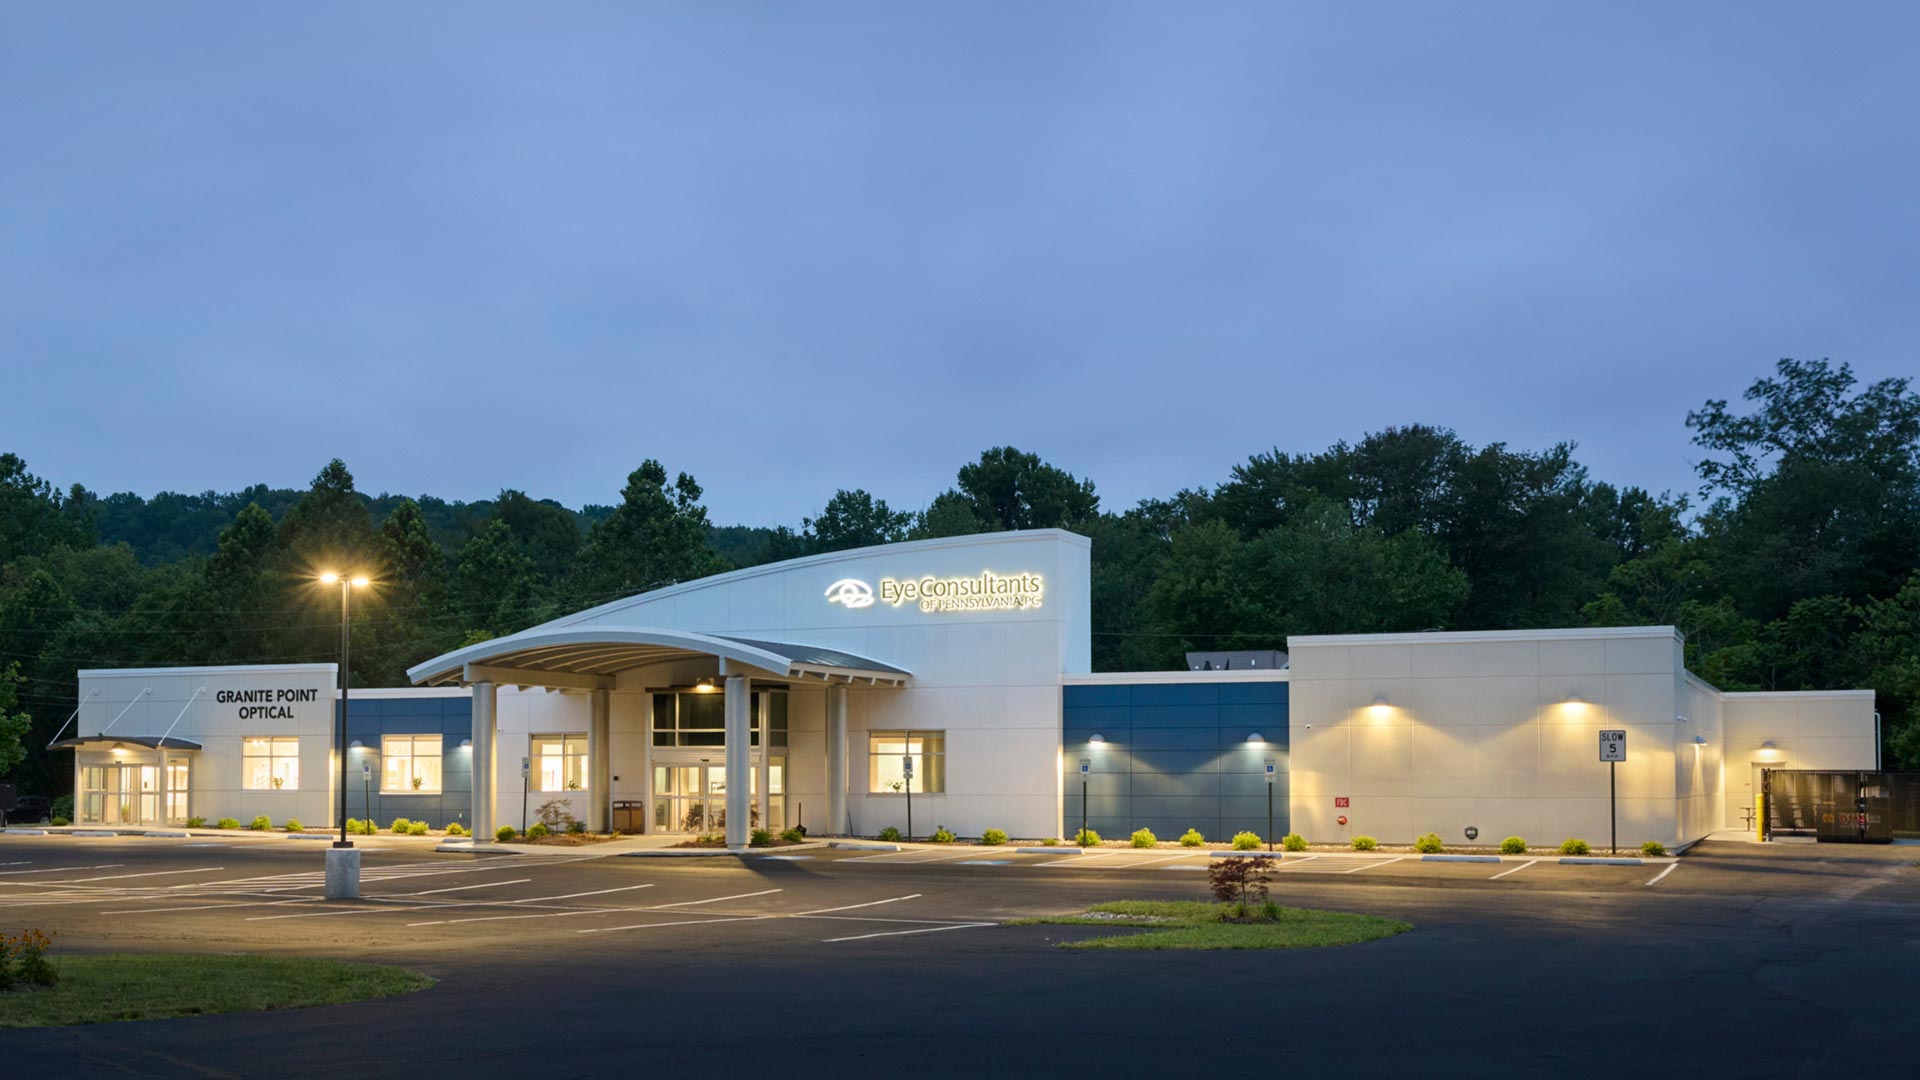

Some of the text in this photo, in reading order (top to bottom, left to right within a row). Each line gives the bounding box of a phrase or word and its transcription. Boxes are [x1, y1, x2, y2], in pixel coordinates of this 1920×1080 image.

[881, 573, 1040, 605] Eye Consultants
[920, 600, 936, 610] OF
[216, 689, 318, 703] GRANITE POINT
[238, 706, 294, 719] OPTICAL
[1601, 732, 1624, 741] SLOW
[1609, 743, 1617, 753] 5
